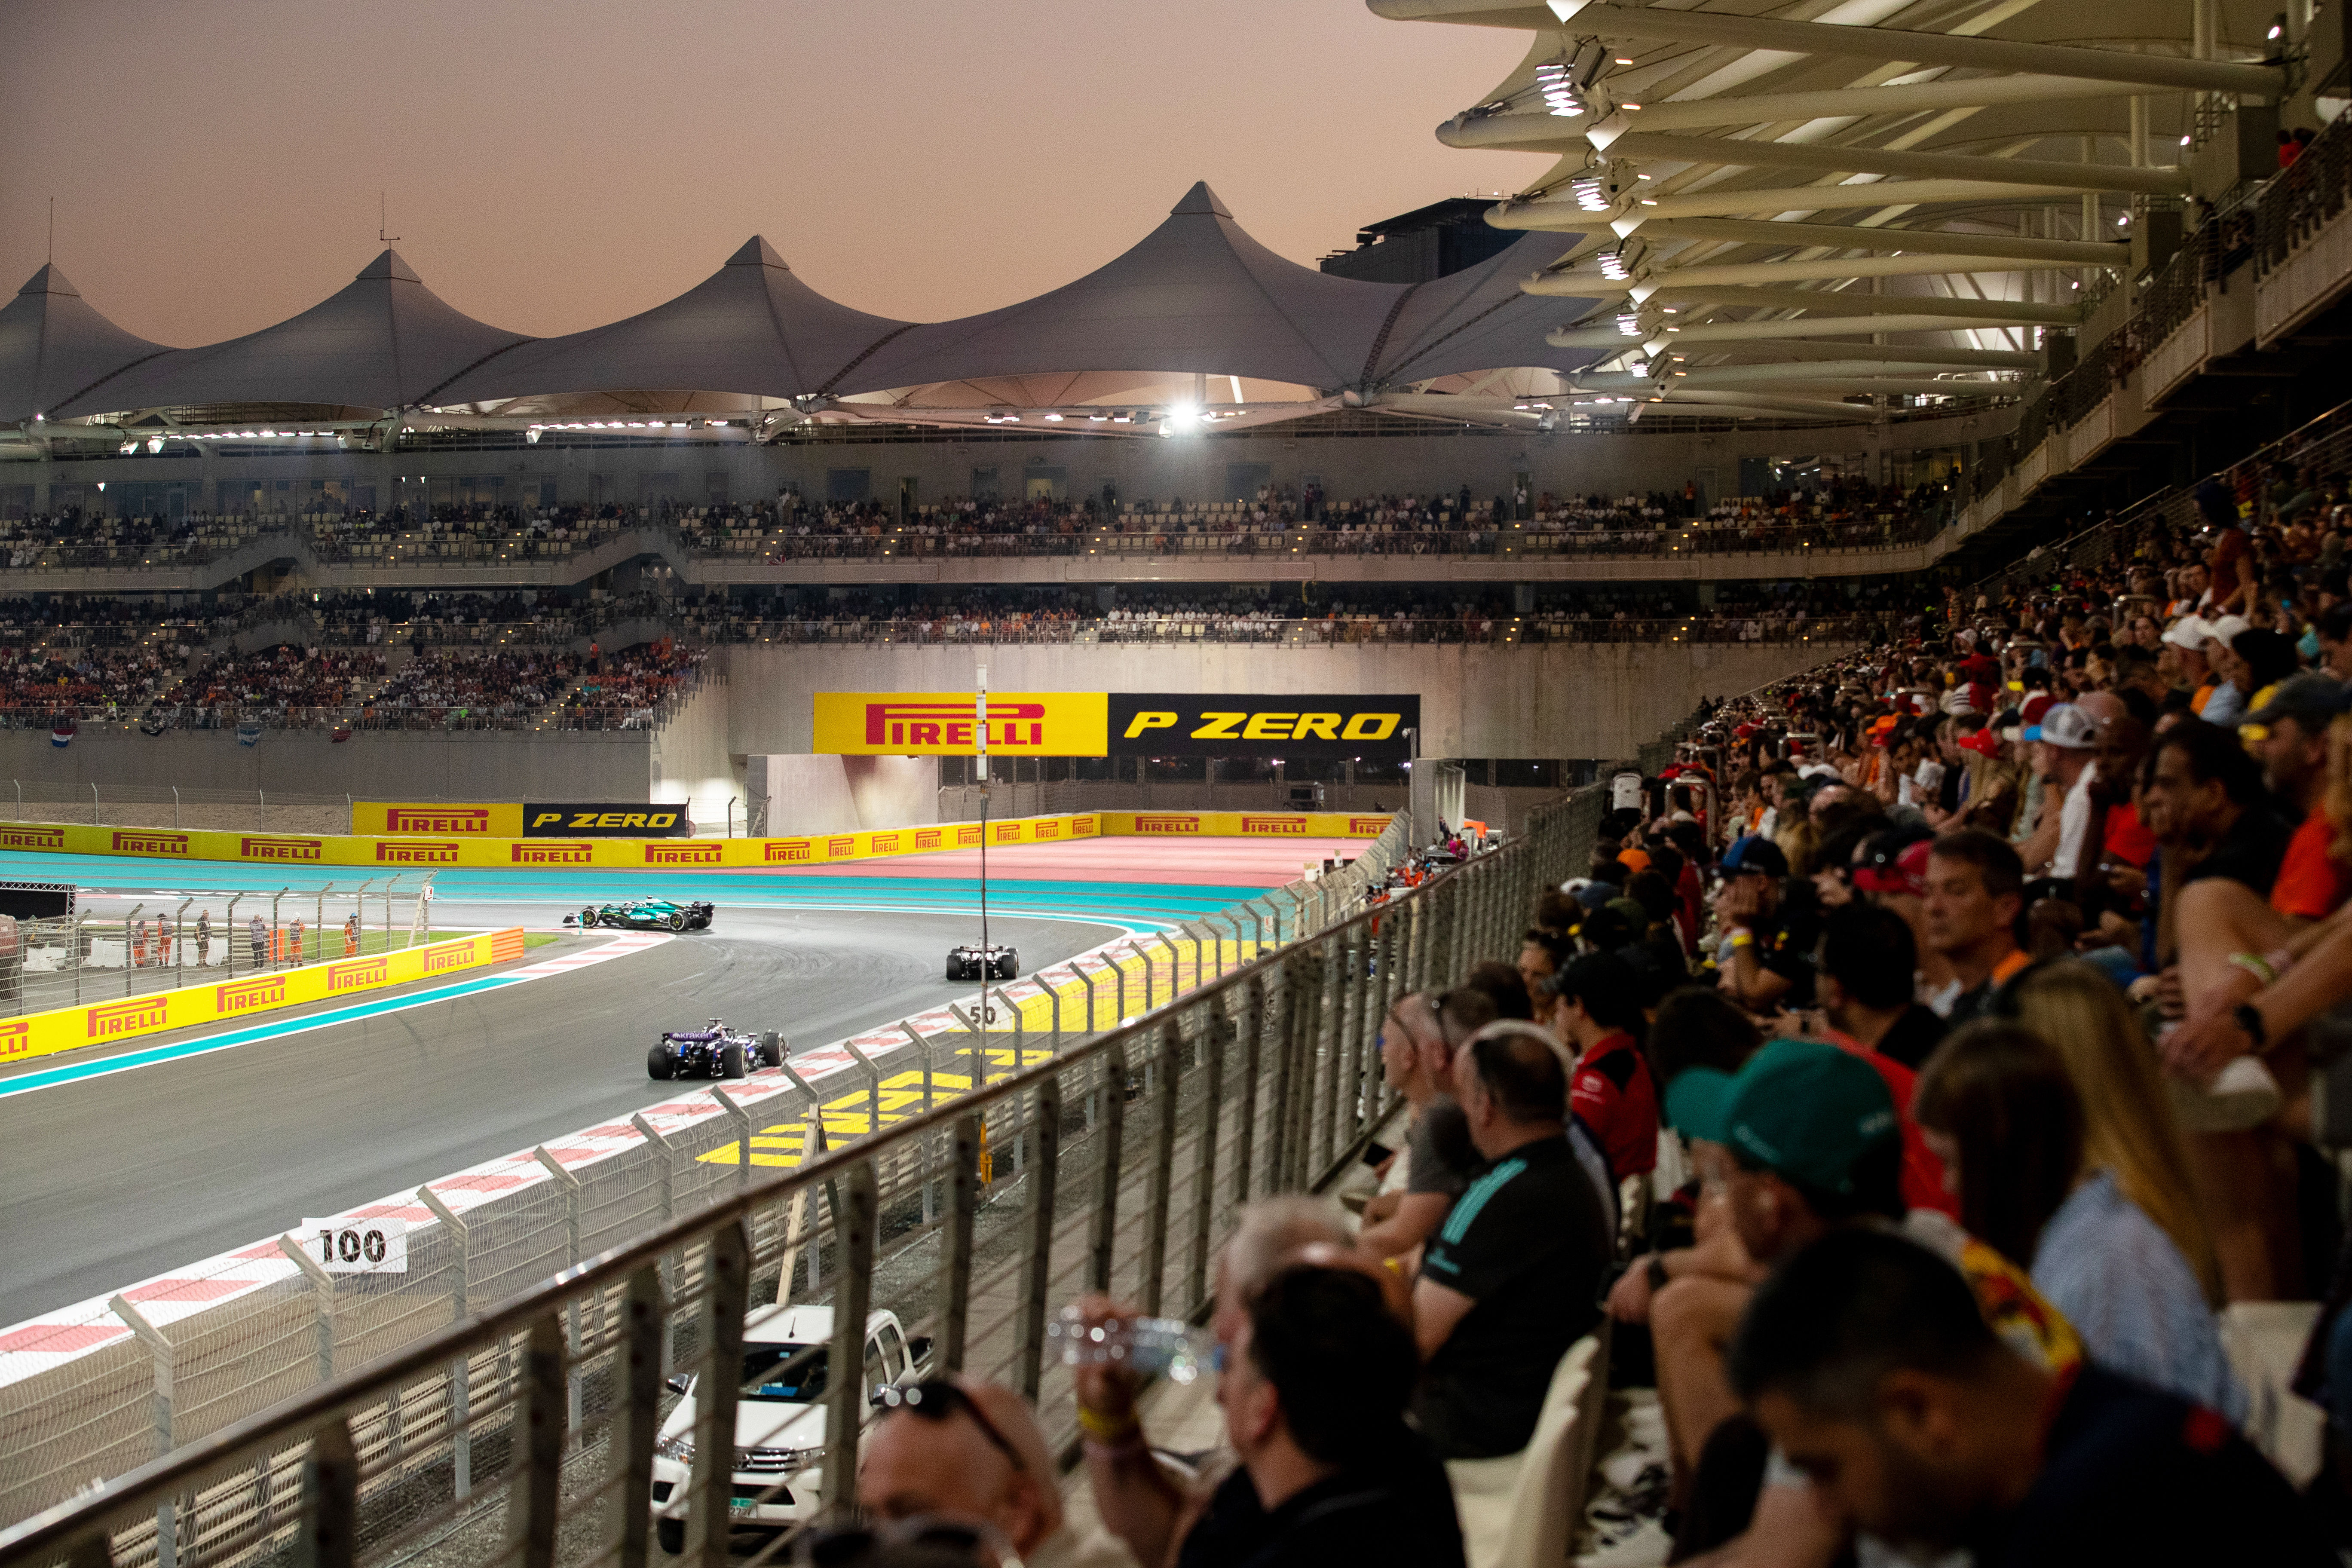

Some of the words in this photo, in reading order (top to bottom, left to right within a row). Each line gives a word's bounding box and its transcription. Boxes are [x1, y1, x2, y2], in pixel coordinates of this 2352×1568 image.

[866, 703, 1045, 745] PIRELLI
[1124, 711, 1178, 738] P
[1190, 712, 1402, 740] ZERO
[387, 808, 489, 832] PIRELLI
[533, 813, 562, 827] P
[568, 813, 678, 828] ZERO
[1035, 821, 1058, 838] PIRELLI
[1072, 818, 1093, 834] PIRELLI
[1135, 816, 1199, 832] PIRELLI
[1242, 817, 1307, 833] PIRELLI
[916, 830, 941, 848] PIRELLI
[958, 827, 981, 845] PIRELLI
[996, 824, 1020, 841] PIRELLI
[112, 832, 188, 854] PIRELLI
[241, 838, 322, 859] PIRELLI
[376, 842, 459, 862] PIRELLI
[765, 842, 810, 861] PIRELLI
[829, 838, 854, 857] PIRELLI
[872, 834, 898, 853] PIRELLI
[511, 844, 593, 862] PIRELLI
[645, 844, 723, 862] PIRELLI
[424, 941, 474, 972] PIRELLI
[328, 958, 387, 991] PIRELLI
[217, 977, 285, 1013] PIRELLI
[88, 997, 167, 1038] PIRELLI
[970, 1006, 995, 1025] 50
[320, 1230, 386, 1262] 100
